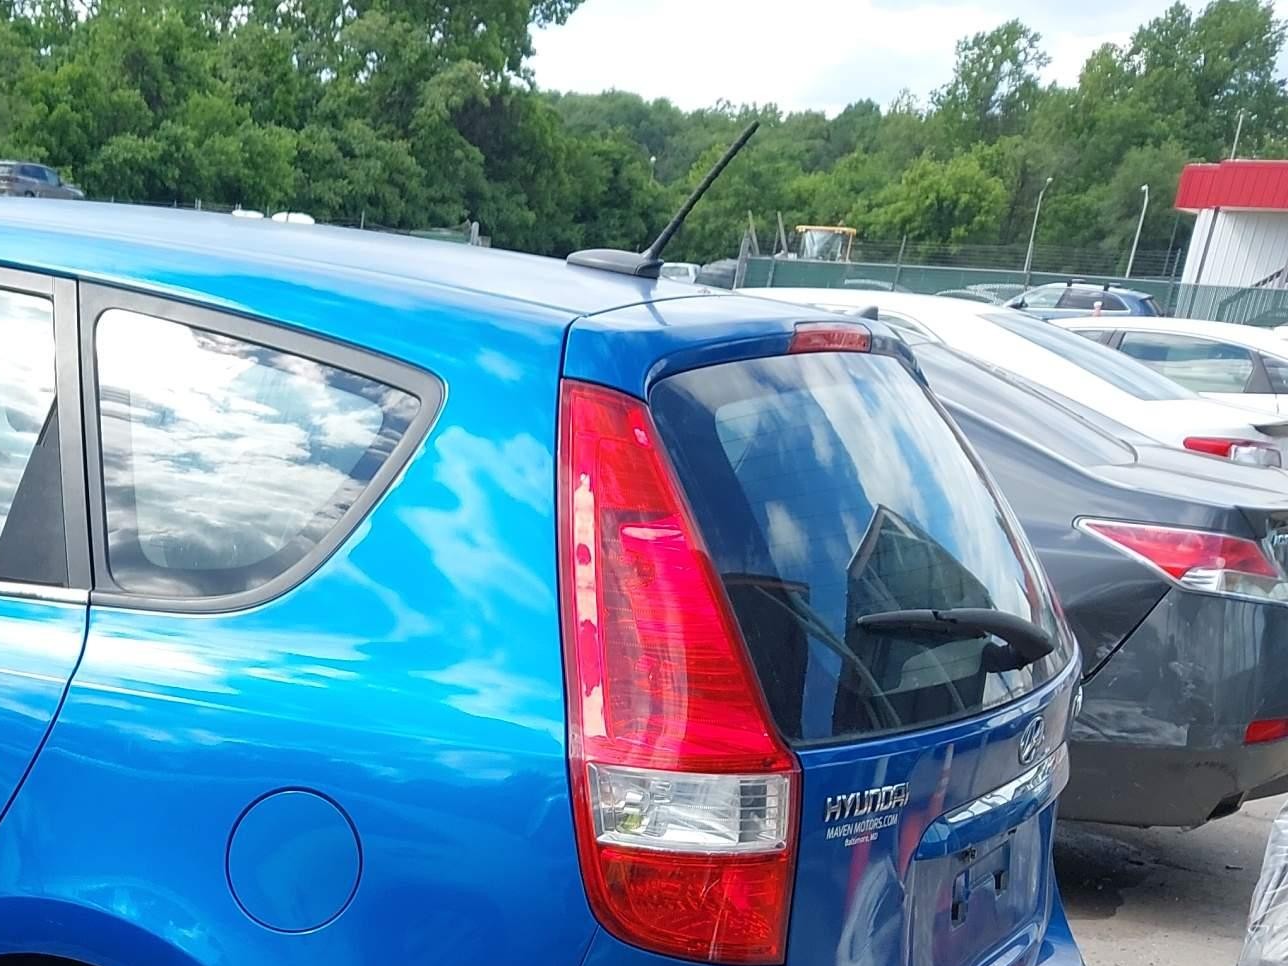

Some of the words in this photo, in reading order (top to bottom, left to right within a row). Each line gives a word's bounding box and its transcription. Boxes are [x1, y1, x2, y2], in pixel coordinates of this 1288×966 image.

[824, 782, 910, 822] HYUNDAI
[826, 823, 853, 839] MAVEN
[853, 813, 898, 835] MOTORS.COM
